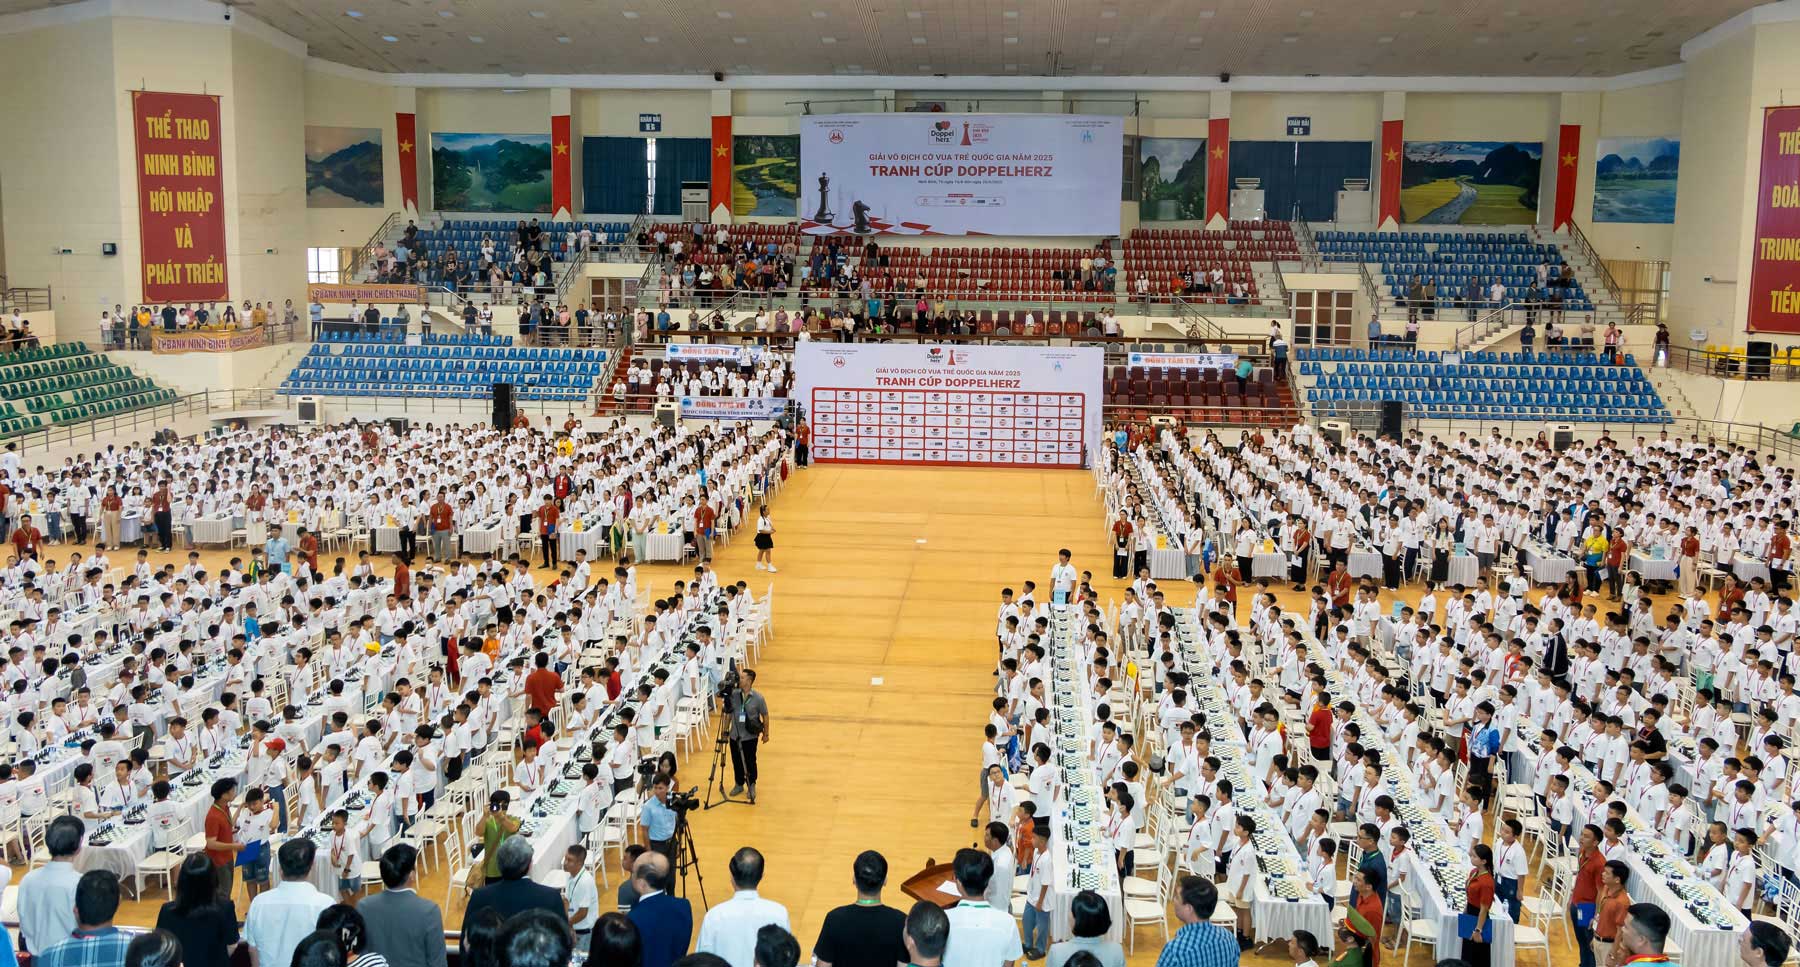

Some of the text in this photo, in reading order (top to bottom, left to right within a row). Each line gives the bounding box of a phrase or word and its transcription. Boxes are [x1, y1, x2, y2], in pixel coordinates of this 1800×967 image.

[146, 109, 210, 140] THỂ THAO
[931, 130, 954, 138] Doppel
[144, 150, 215, 176] NINH BÌNH
[869, 152, 886, 161] GIẢI
[901, 153, 920, 162] ĐỊCH
[954, 152, 969, 161] TRẺ
[971, 152, 994, 161] QUỐC
[1012, 152, 1031, 161] NĂM
[869, 163, 1053, 177] TRANH CÚP DOPPELHERZ
[149, 186, 214, 217] HỘI NHẬP
[175, 223, 193, 248] VÀ
[146, 254, 224, 284] PHÁT TRIỂN
[188, 337, 206, 349] NINH
[876, 375, 1021, 388] TRANH CÚP DOPPELHERZ
